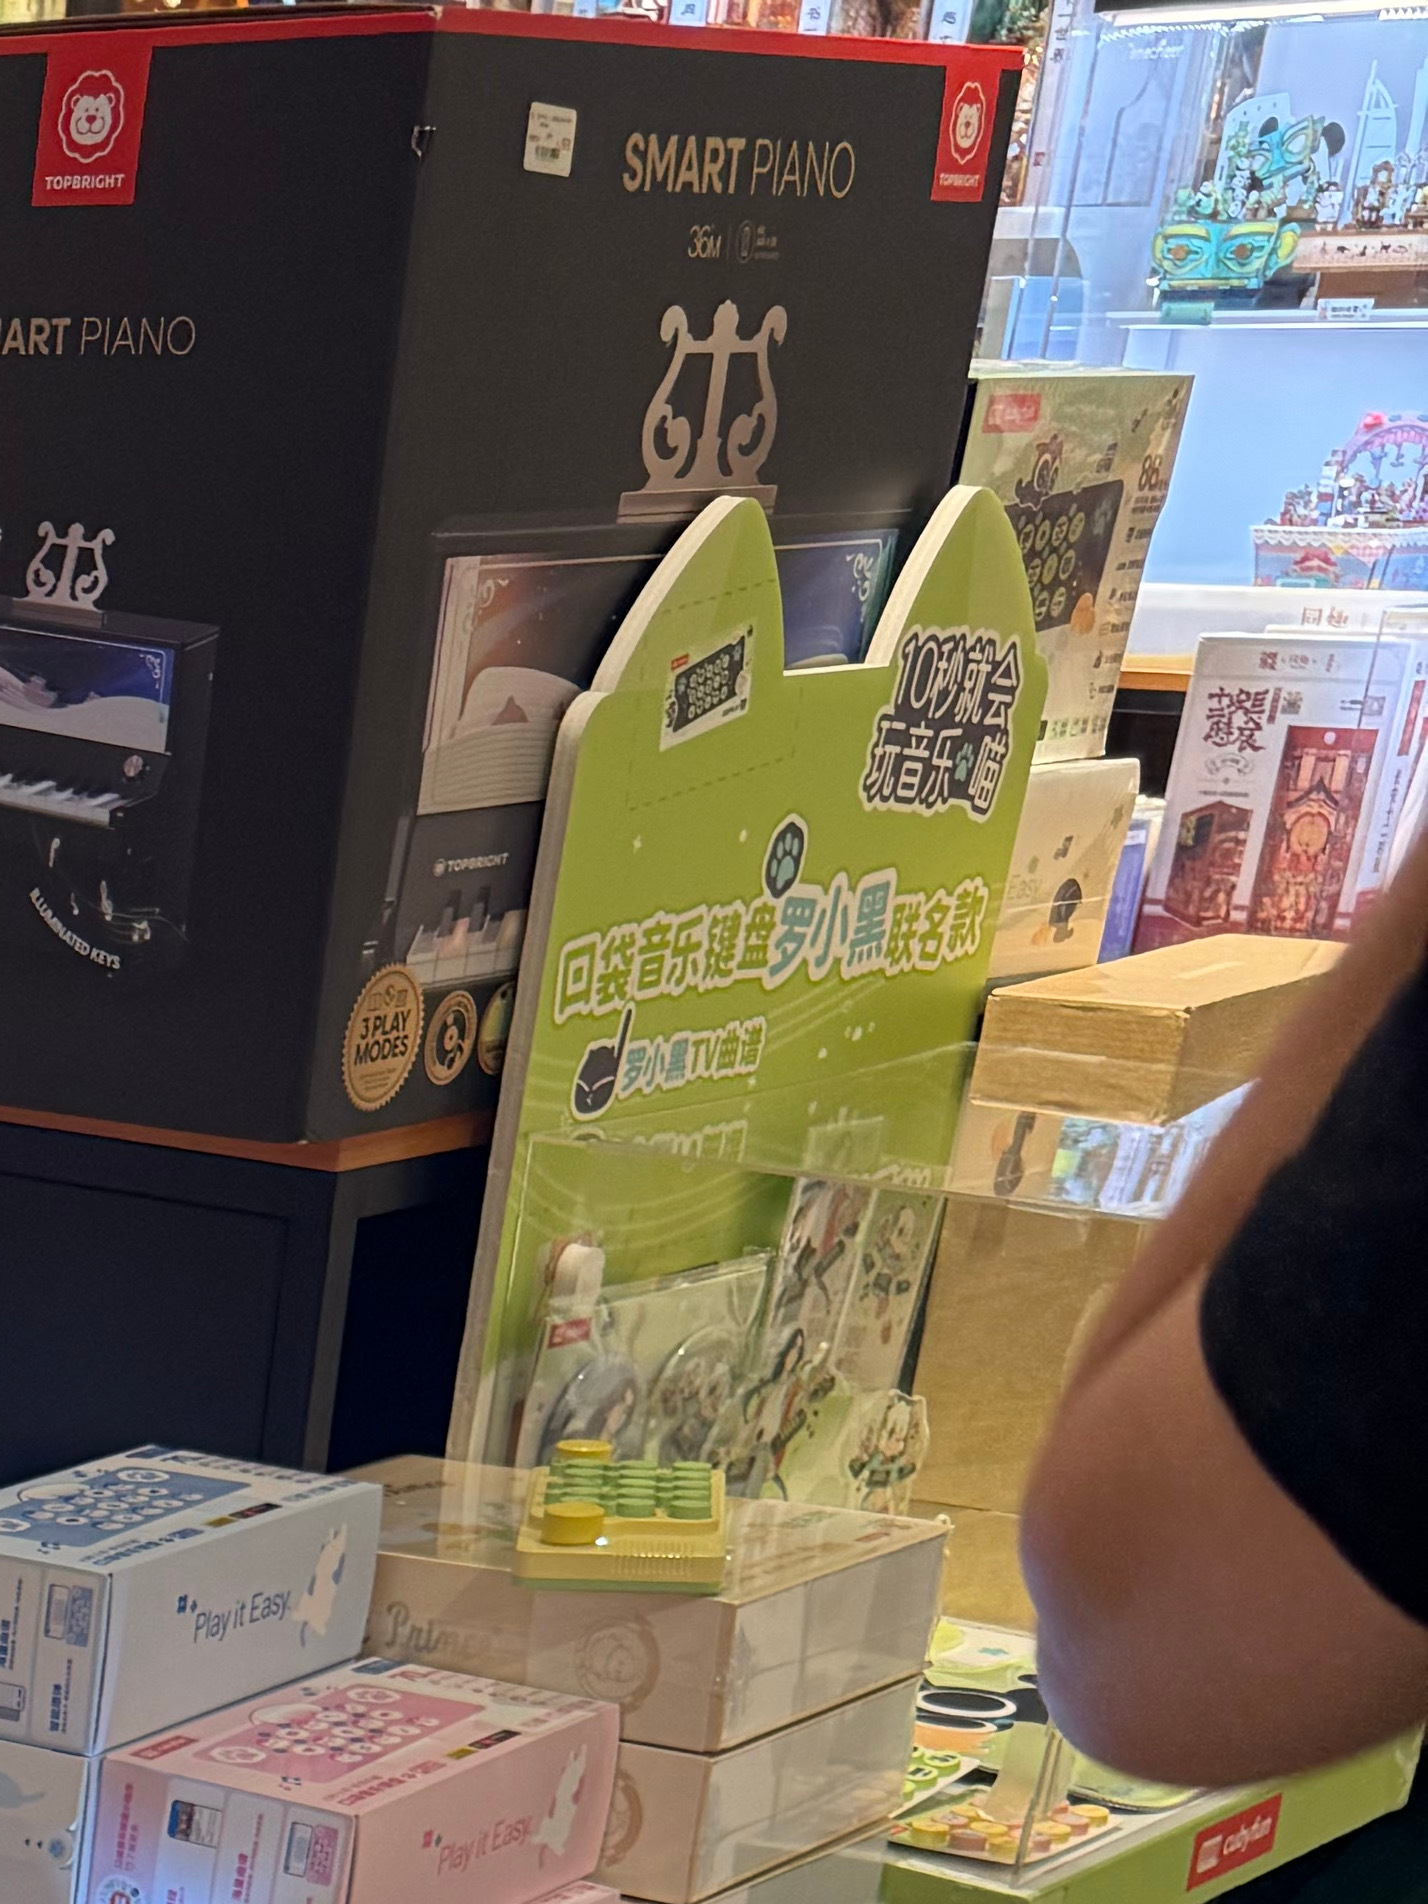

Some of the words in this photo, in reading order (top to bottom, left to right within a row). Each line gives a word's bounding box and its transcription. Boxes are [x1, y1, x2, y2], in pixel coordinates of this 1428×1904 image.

[45, 173, 125, 191] TOPBRIGHT
[623, 132, 746, 194] SMART
[749, 137, 856, 200] PIANO
[79, 315, 196, 356] PIANO
[893, 632, 1021, 735] 10秒就会
[29, 887, 91, 961] ILLUMINATED
[89, 945, 122, 972] KEYS
[354, 1034, 409, 1066] MODES
[360, 1017, 371, 1040] 3
[371, 1009, 412, 1037] PLAY
[620, 1018, 766, 1099] 罗小黑TV曲谱
[193, 1609, 232, 1644] Play
[231, 1601, 247, 1630] it
[248, 1588, 293, 1625] Easy
[437, 1843, 474, 1874] Play
[475, 1834, 488, 1862] it
[490, 1822, 532, 1859] Easy
